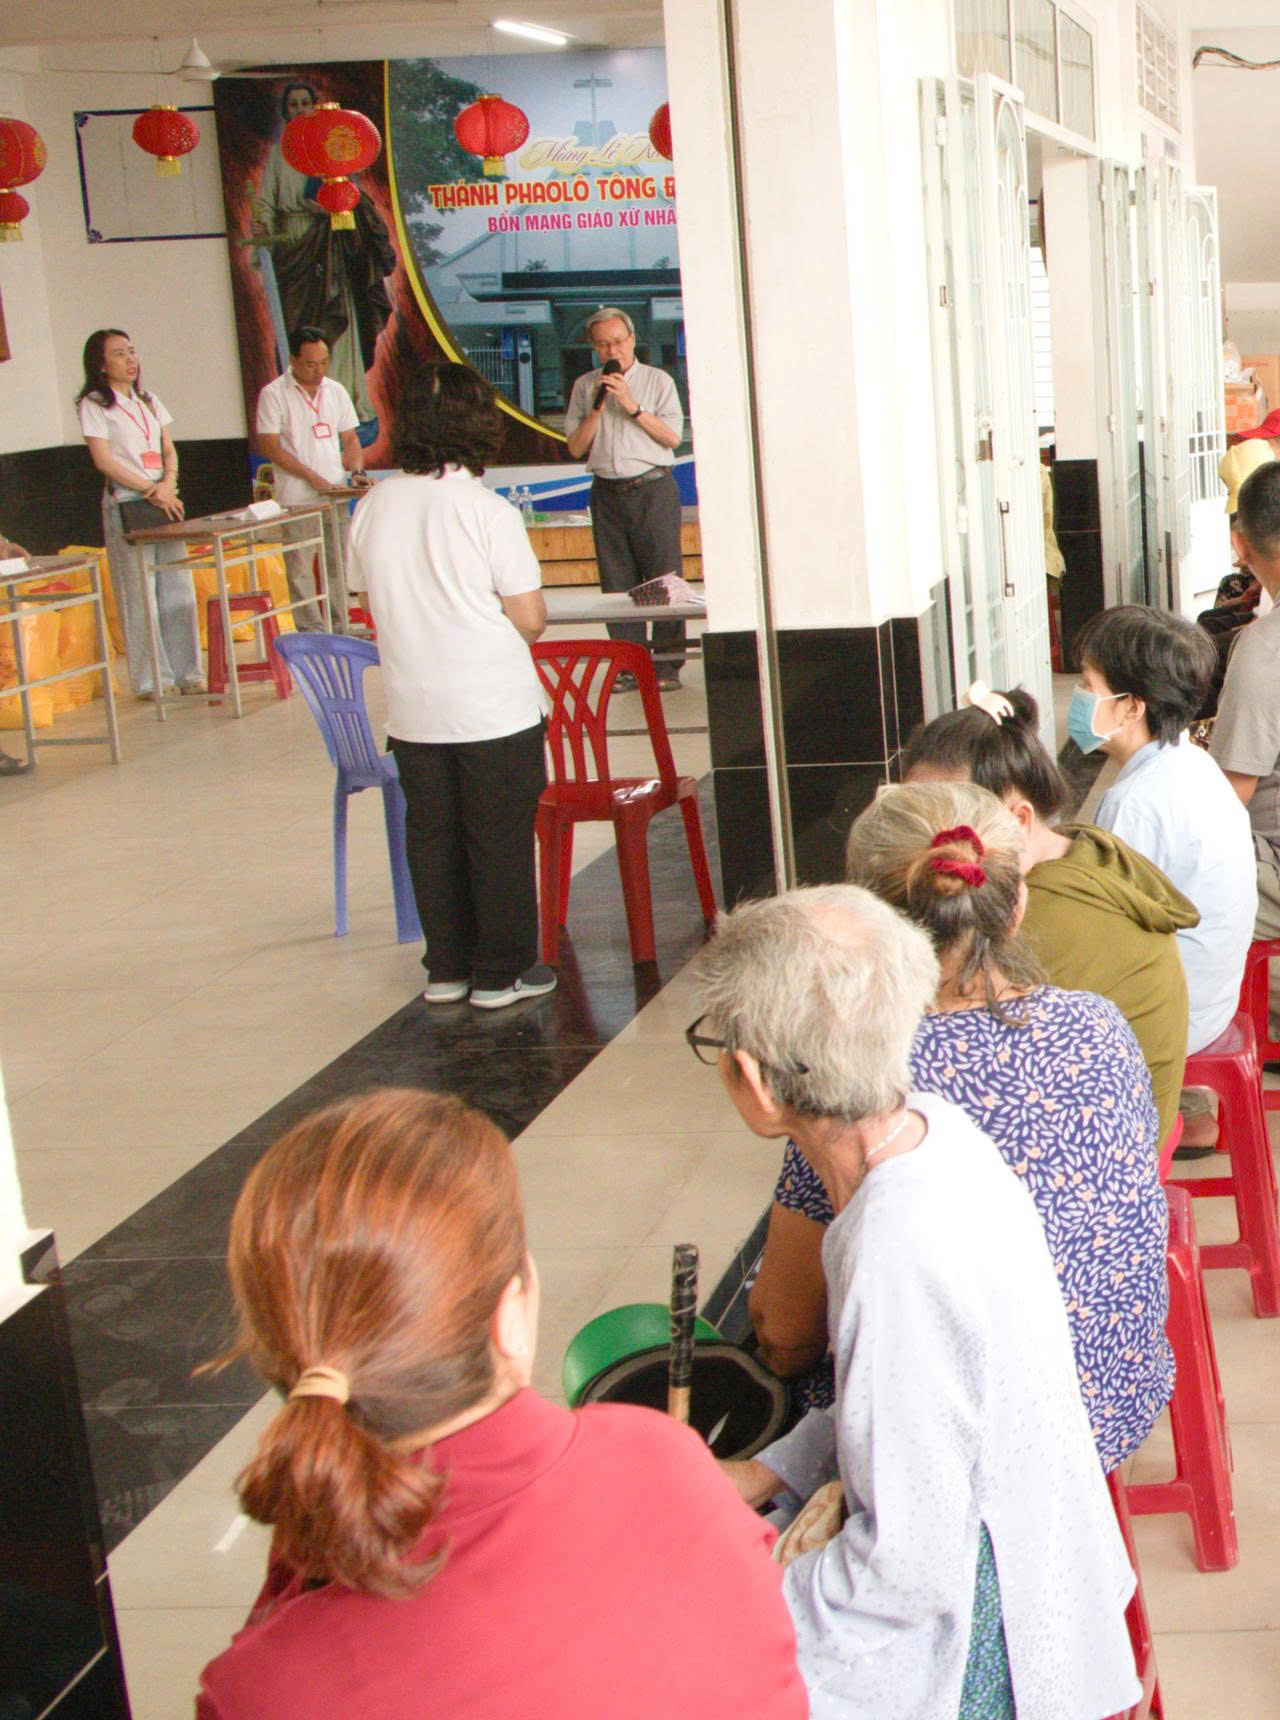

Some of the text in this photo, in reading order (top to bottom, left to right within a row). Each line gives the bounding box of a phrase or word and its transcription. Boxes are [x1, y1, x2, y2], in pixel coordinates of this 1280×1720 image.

[504, 174, 590, 205] PHAOLÔ
[596, 172, 656, 201] TÔNG
[663, 176, 676, 198] Đ
[525, 213, 573, 234] MẠNG
[577, 208, 614, 230] GIÁO
[618, 206, 641, 227] XỨ
